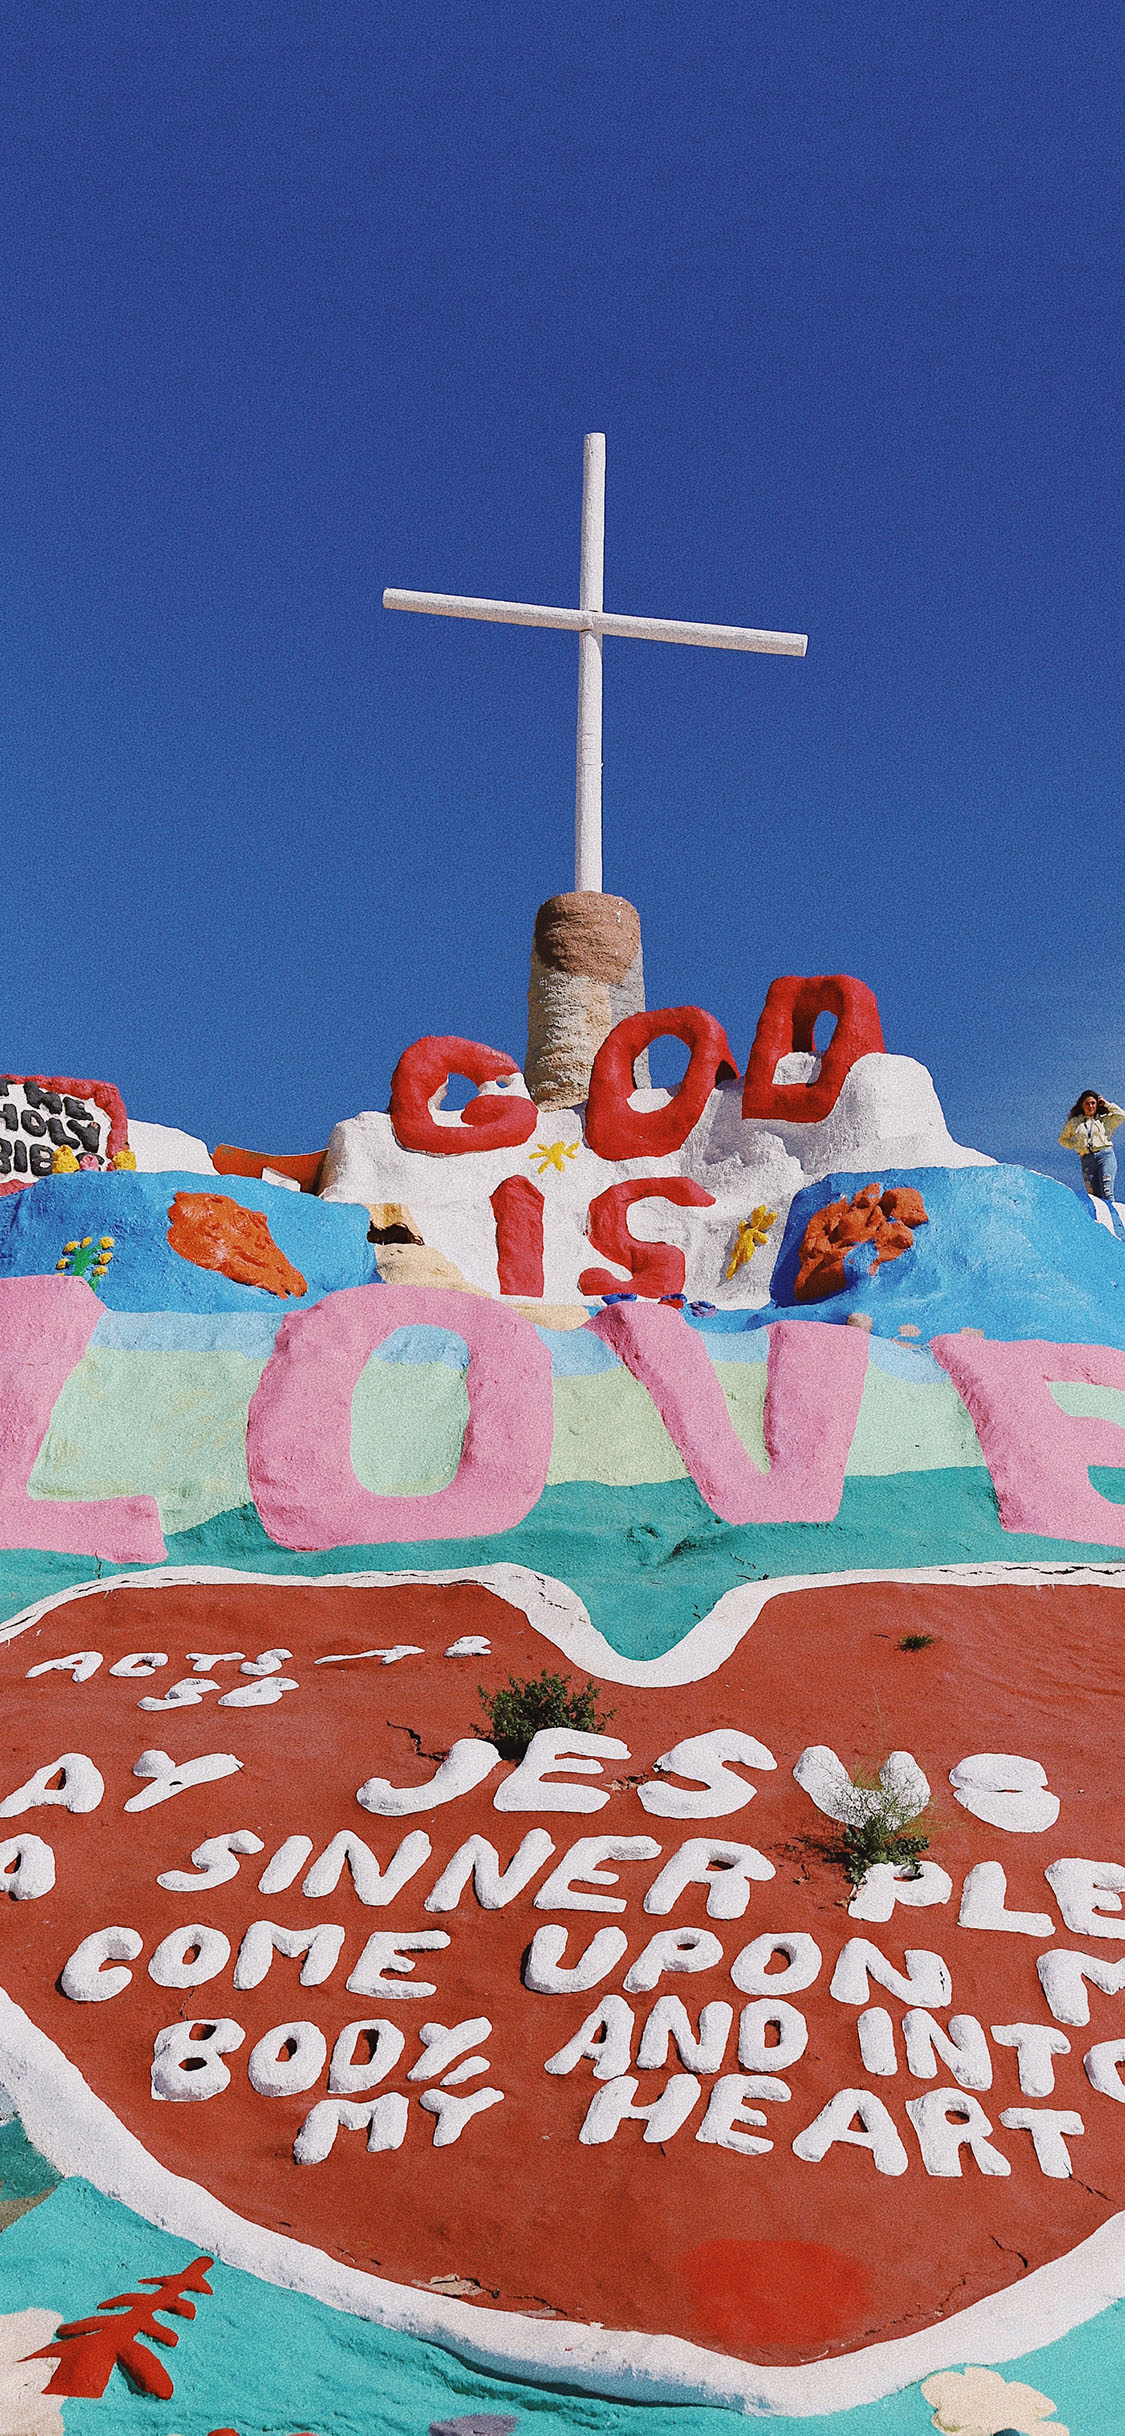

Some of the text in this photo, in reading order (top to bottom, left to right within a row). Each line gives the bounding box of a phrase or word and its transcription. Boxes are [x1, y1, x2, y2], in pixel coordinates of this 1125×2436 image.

[390, 974, 886, 1160] GOD
[489, 1175, 716, 1298] IS
[0, 1274, 1125, 1565] LOVE
[24, 1650, 293, 1683] ACTS
[356, 1726, 1060, 1833] JESUS
[156, 1826, 777, 1921] SINNER
[60, 1919, 452, 2001] COME
[524, 1924, 953, 2009] UPON
[544, 1994, 808, 2080] AND
[294, 2073, 1085, 2179] MY HEART
